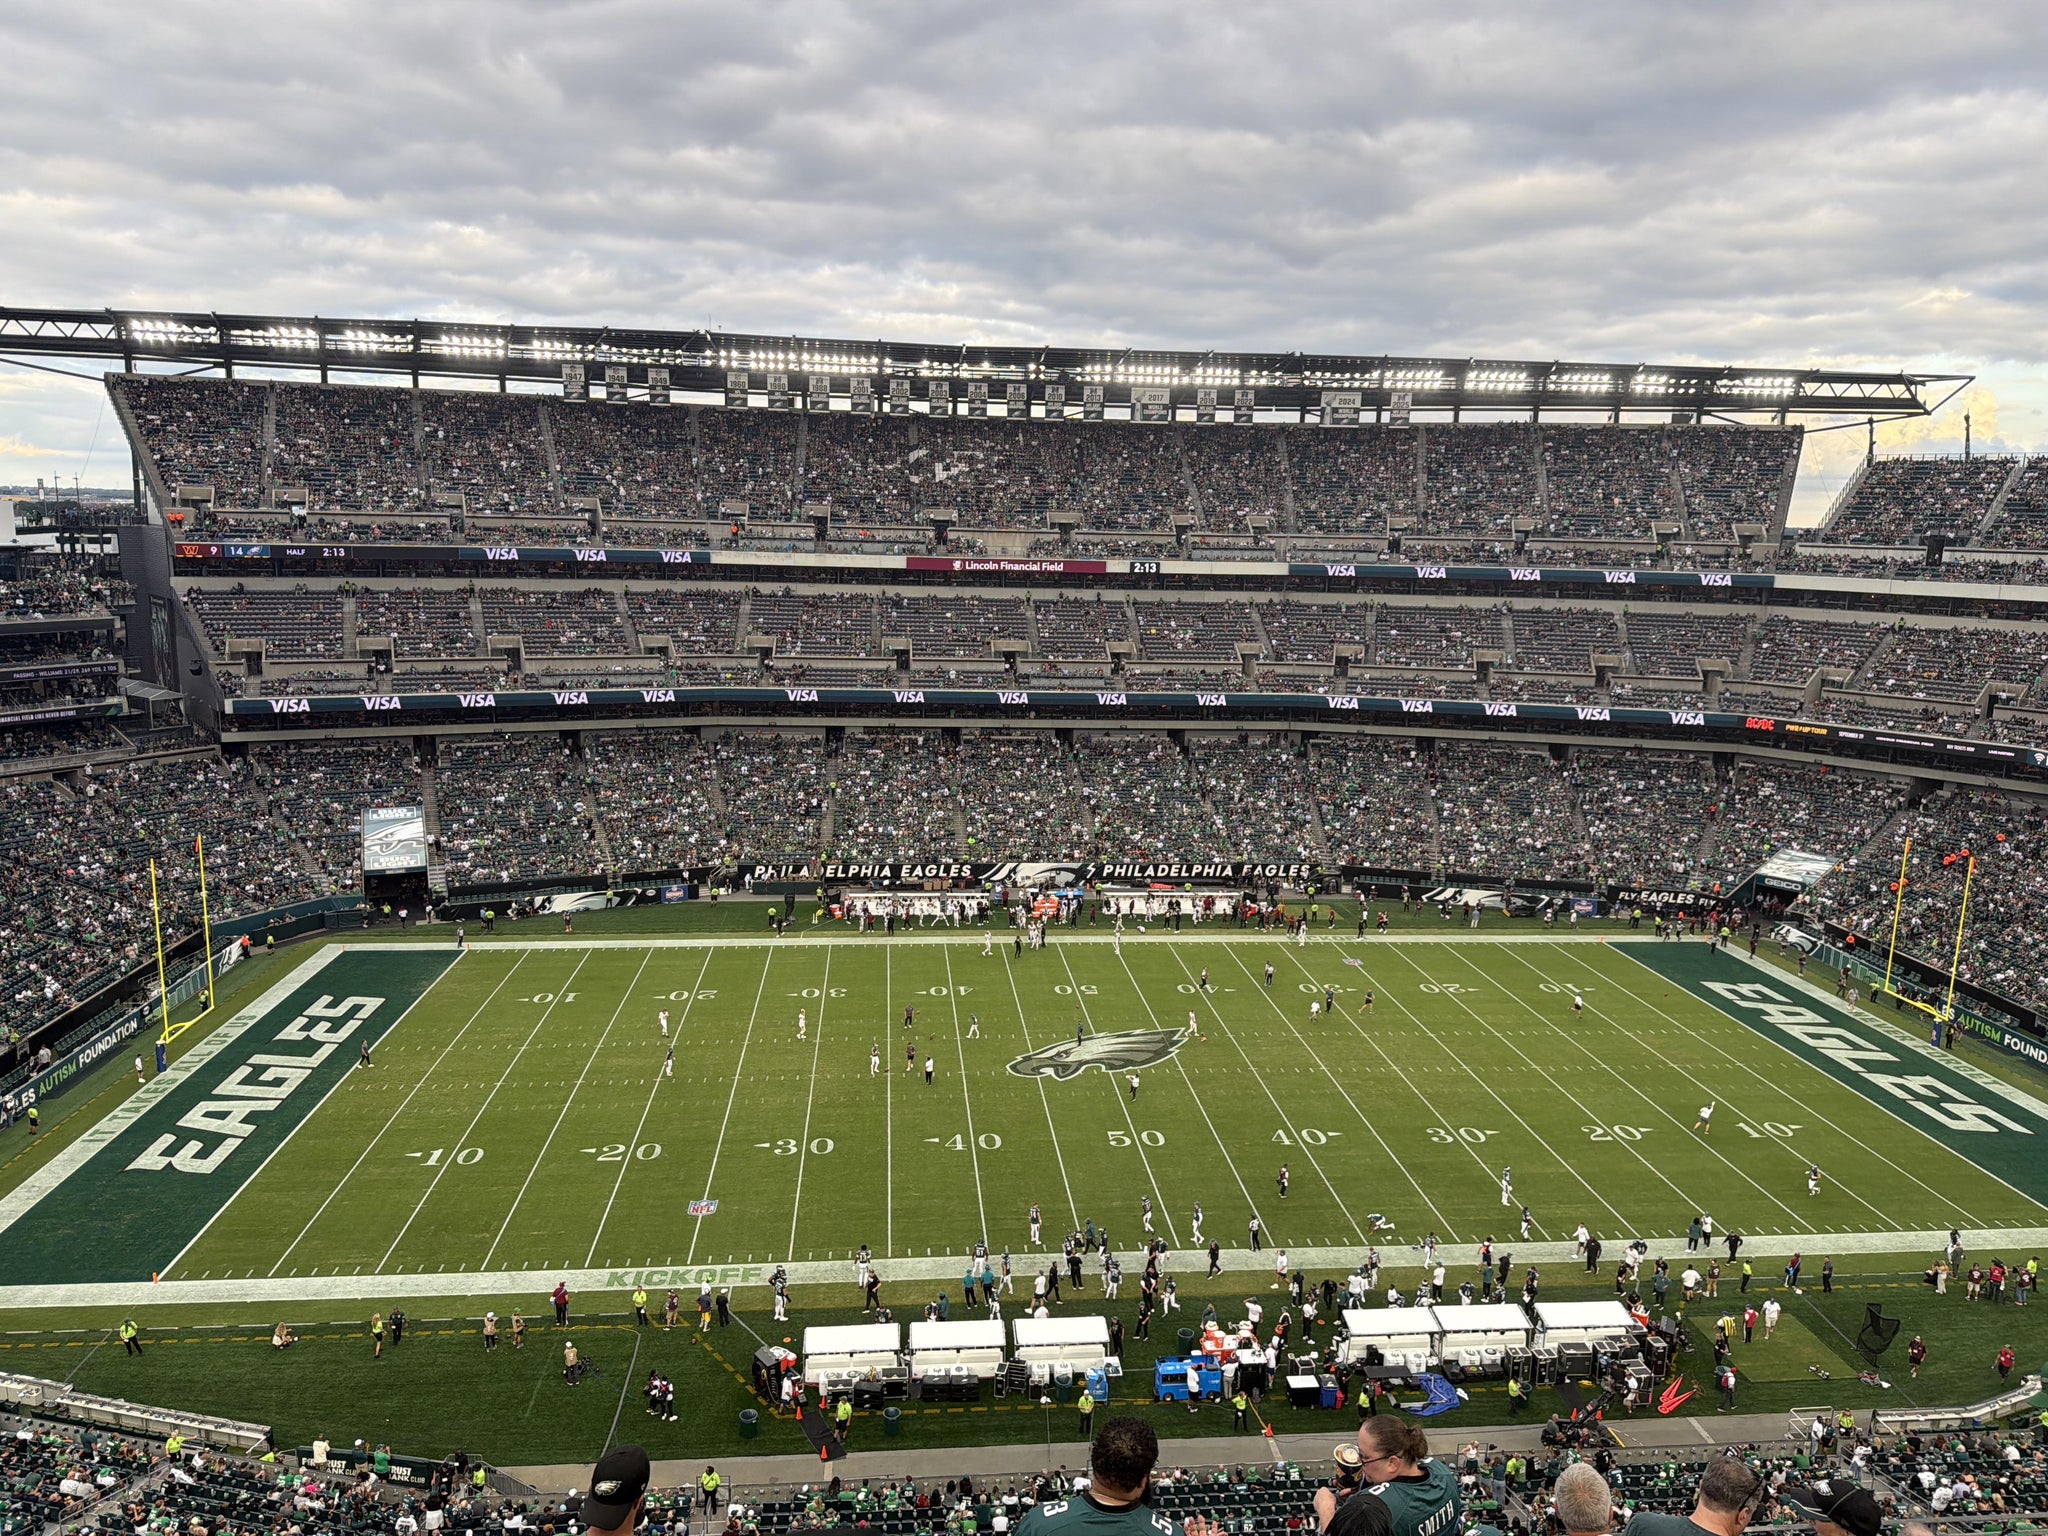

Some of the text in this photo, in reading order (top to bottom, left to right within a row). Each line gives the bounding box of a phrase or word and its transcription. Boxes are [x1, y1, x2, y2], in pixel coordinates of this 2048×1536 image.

[730, 380, 746, 388] 1960
[852, 386, 869, 394] 2001
[1148, 394, 1164, 402] 2017
[1236, 398, 1252, 406] 2022
[1338, 398, 1356, 406] 2024
[210, 547, 218, 555] 9
[230, 547, 243, 556] 14
[322, 548, 345, 557] 2:13
[483, 547, 518, 559] VISA
[573, 549, 606, 561] VISA
[660, 551, 691, 563] VISA
[966, 561, 1064, 572] Lincoln Financial Field
[1134, 563, 1158, 573] 2:13
[1325, 564, 1355, 576] VISA
[1415, 565, 1446, 578] VISA
[1508, 568, 1541, 581] VISA
[1603, 571, 1636, 584] VISA
[1699, 573, 1732, 586] VISA
[457, 695, 495, 707] VISA
[551, 692, 588, 704] VISA
[641, 690, 675, 702] VISA
[785, 690, 818, 702] VISA
[893, 691, 924, 703] VISA
[997, 692, 1028, 704] VISA
[1096, 693, 1127, 705] VISA
[1196, 694, 1227, 706] VISA
[268, 699, 310, 712] VISA
[361, 697, 401, 710] VISA
[1326, 697, 1358, 709] VISA
[1400, 700, 1433, 712] VISA
[1482, 704, 1517, 716] VISA
[1575, 707, 1610, 720] VISA
[1669, 712, 1704, 724] VISA
[1812, 726, 1828, 735] TOUR
[900, 864, 972, 878] EAGLES
[1102, 864, 1233, 878] PHILADELPHIA
[1764, 878, 1802, 891] GEICO
[1618, 892, 1637, 900] FLY
[1640, 890, 1696, 906] EAGLES
[801, 986, 848, 998] 30
[929, 985, 975, 996] 40
[1054, 984, 1100, 996] 50
[1418, 982, 1468, 994] 20
[532, 992, 581, 1004] 10
[668, 989, 718, 1002] 20
[1958, 1013, 2002, 1042] AUTISM
[2003, 1034, 2048, 1065] FOUND
[38, 1059, 78, 1097] AUTISM
[78, 1018, 138, 1068] FOUNDATION
[1698, 980, 2036, 1135] EAGLES
[1915, 1044, 2006, 1087] FORGET
[80, 1129, 116, 1144] IT
[108, 1078, 180, 1122] TAKES
[172, 1050, 214, 1072] ALL
[204, 1034, 230, 1046] OF
[226, 1014, 257, 1028] US
[123, 994, 387, 1175] EAGLES
[1426, 1126, 1486, 1145] 30
[1580, 1124, 1641, 1142] 20
[1734, 1120, 1792, 1140] 10
[944, 1132, 1003, 1152] 40
[1106, 1130, 1166, 1148] 50
[1270, 1128, 1329, 1146] 40
[596, 1142, 662, 1162] 20
[772, 1138, 835, 1157] 30
[419, 1147, 485, 1166] 10
[691, 1206, 713, 1214] NFL
[606, 1266, 763, 1288] KICKOFF
[410, 1476, 426, 1484] CLUB
[1616, 1474, 1622, 1484] 3
[1418, 1500, 1454, 1536] SMITH
